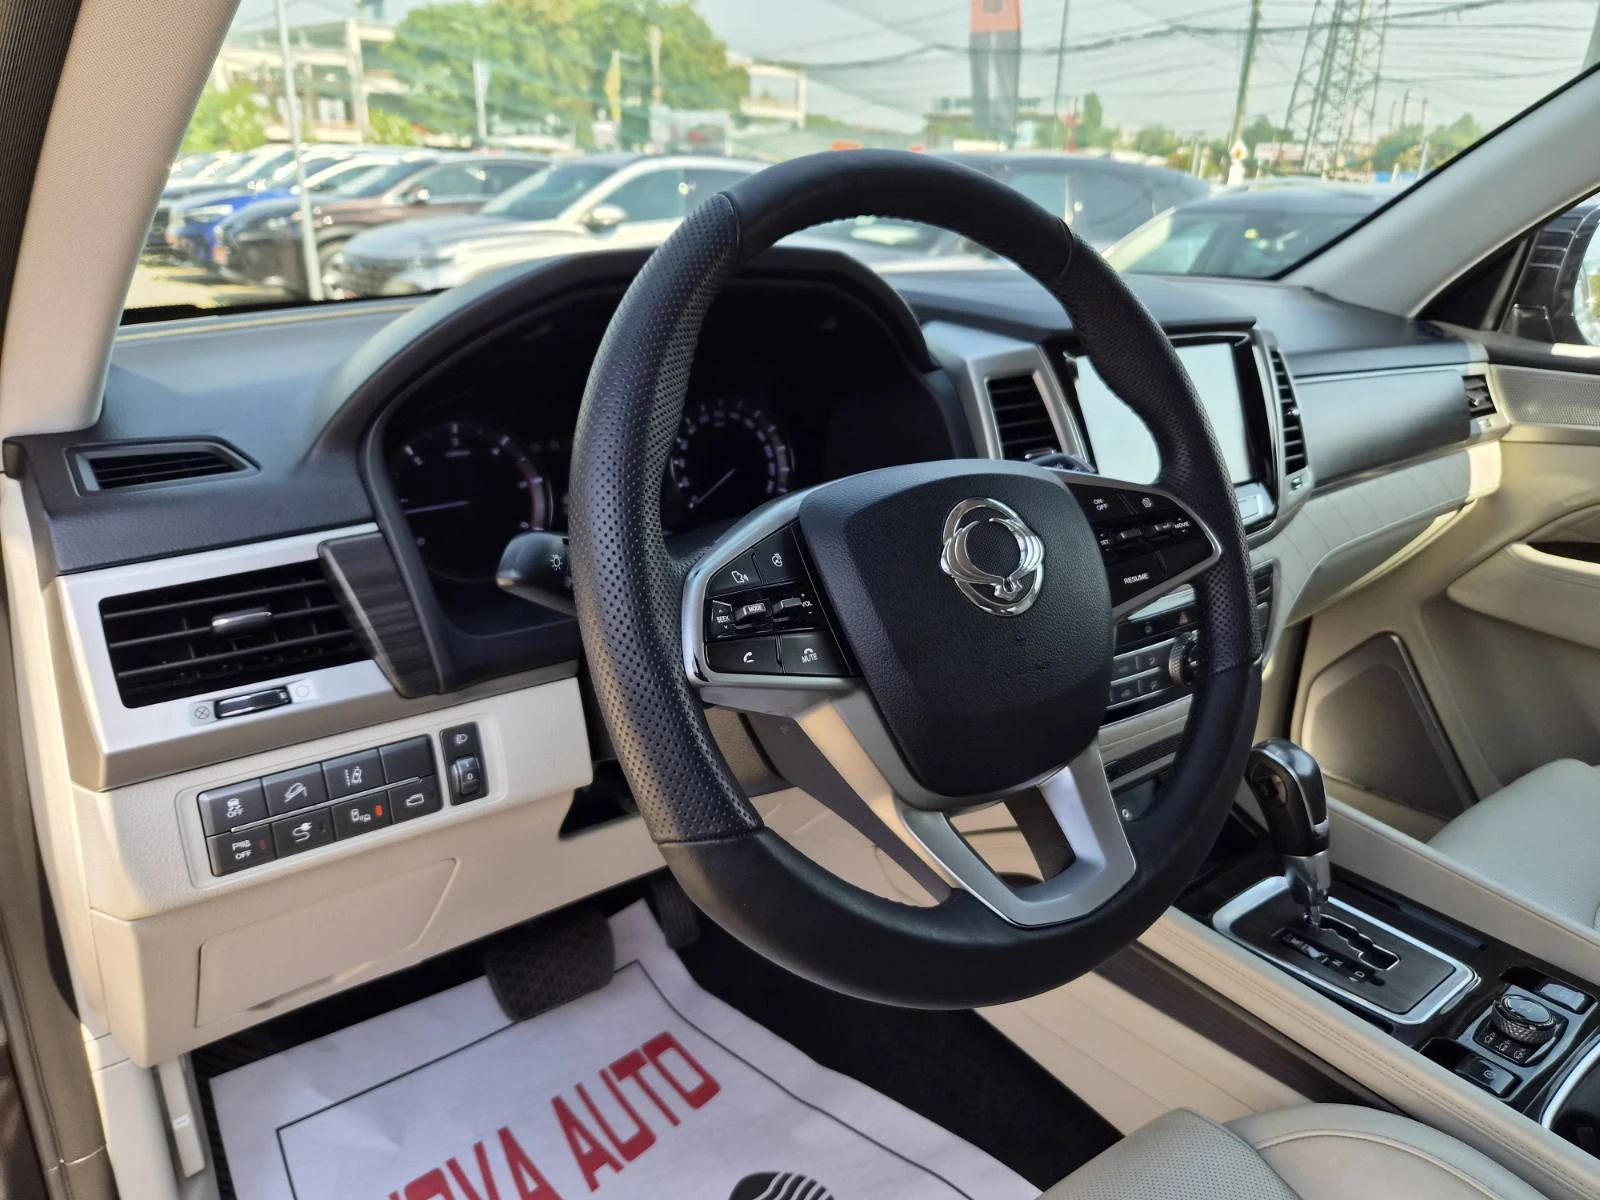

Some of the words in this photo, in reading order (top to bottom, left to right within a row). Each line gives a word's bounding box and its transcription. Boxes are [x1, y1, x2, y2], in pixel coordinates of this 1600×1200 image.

[1096, 503, 1108, 511] OFF
[1123, 572, 1149, 585] RESUME
[716, 615, 730, 624] SEEK
[801, 653, 819, 664] MUTE
[226, 807, 245, 819] OFF
[234, 849, 253, 861] OFF
[388, 1126, 564, 1200] VA
[551, 1031, 721, 1192] AUTO
